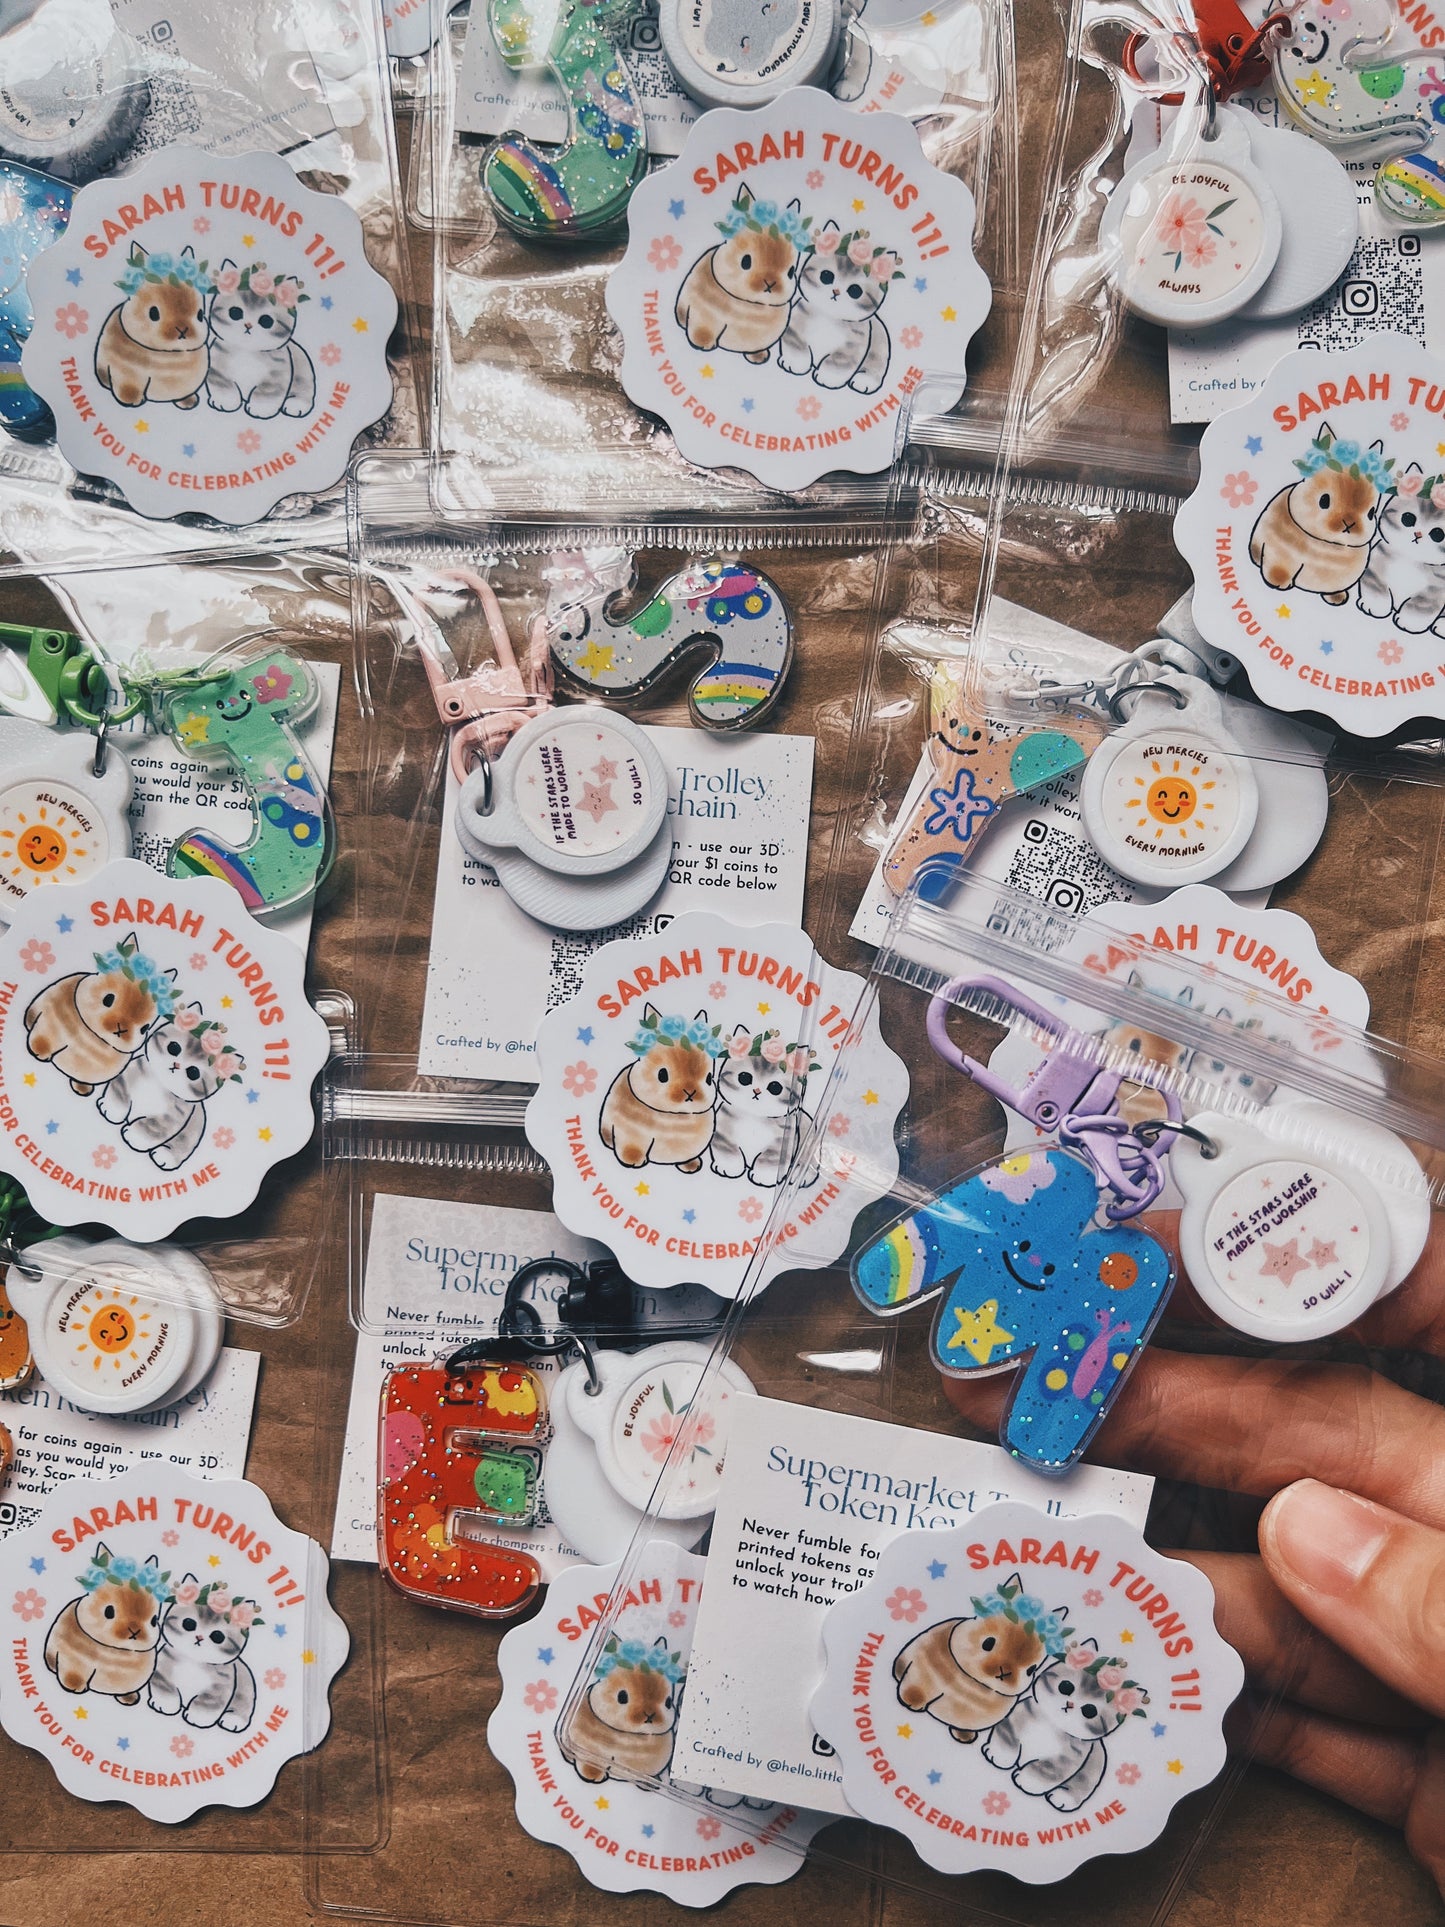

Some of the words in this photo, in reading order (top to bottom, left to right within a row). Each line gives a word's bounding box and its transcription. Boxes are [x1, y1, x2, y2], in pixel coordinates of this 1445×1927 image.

[757, 26, 805, 78] WONDERFULLY
[801, 1, 812, 27] MADE
[879, 71, 906, 100] ME
[692, 130, 805, 195] SARAH
[821, 132, 919, 211] TURNS
[911, 211, 950, 261] 11!
[1190, 174, 1230, 193] JOYFUL
[83, 184, 186, 259] SARAH
[199, 181, 303, 237] TURNS
[304, 233, 345, 280] 11!
[1158, 279, 1201, 294] ALWAYS
[643, 289, 665, 355] THANK
[658, 360, 686, 397] YOU
[683, 396, 717, 427] FOR
[719, 422, 852, 452] CELEBRATING
[854, 393, 900, 432] WITH
[1188, 377, 1237, 392] Crafted
[1241, 377, 1256, 392] by
[1272, 372, 1391, 433] SARAH
[61, 357, 96, 422] THANK
[93, 422, 125, 457] YOU
[127, 453, 162, 480] FOR
[167, 452, 296, 491] CELEBRATING
[295, 412, 335, 453] WITH
[329, 382, 350, 409] ME
[1215, 526, 1239, 594] THANK
[1231, 597, 1262, 636] YOU
[1258, 635, 1295, 670] FOR
[1297, 664, 1436, 697] CELEBRATING
[130, 757, 165, 770] coins
[170, 760, 209, 774] again
[539, 745, 553, 774] WERE
[552, 746, 569, 793] WORSHIP
[1142, 746, 1163, 760] NEW
[1166, 745, 1209, 765] MERCIES
[152, 775, 192, 789] would
[196, 781, 226, 794] your
[230, 779, 244, 793] $1
[544, 777, 559, 808] STARS
[628, 765, 643, 790] WILL
[676, 767, 774, 801] Trolley
[36, 793, 58, 805] NEW
[58, 800, 93, 833] MERCIES
[132, 787, 163, 803] Scan
[169, 792, 190, 806] the
[195, 793, 219, 808] QR
[560, 796, 571, 810] TO
[632, 791, 643, 806] SO
[1039, 795, 1051, 808] it
[550, 812, 562, 832] THE
[562, 812, 578, 840] MADE
[555, 836, 565, 844] IF
[699, 842, 723, 853] use
[729, 844, 753, 855] our
[759, 843, 780, 857] 3D
[1125, 834, 1157, 854] EVERY
[1158, 842, 1205, 857] MORNING
[461, 874, 477, 887] to
[669, 857, 700, 871] your
[704, 856, 719, 871] $1
[724, 860, 759, 873] coins
[764, 862, 779, 875] to
[669, 870, 693, 885] QR
[698, 873, 731, 888] code
[736, 874, 778, 891] below
[1216, 928, 1312, 1003] TURNS
[89, 896, 206, 940] SARAH
[211, 927, 285, 1027] TURNS
[261, 1038, 292, 1081] 11!
[596, 948, 703, 1019] SARAH
[717, 947, 822, 1008] TURNS
[436, 1033, 483, 1049] Crafted
[487, 1037, 502, 1053] by
[14, 1133, 132, 1203] CELEBRATING
[138, 1179, 188, 1203] WITH
[191, 1162, 221, 1187] ME
[565, 1115, 597, 1182] THANK
[591, 1182, 625, 1219] YOU
[623, 1215, 660, 1247] FOR
[798, 1182, 840, 1226] WITH
[1213, 1237, 1226, 1252] IF
[1226, 1220, 1249, 1242] THE
[1248, 1195, 1283, 1226] STARS
[1281, 1172, 1314, 1200] WERE
[1226, 1233, 1256, 1262] MADE
[1254, 1222, 1272, 1238] TO
[1271, 1185, 1319, 1227] WORSHIP
[1302, 1296, 1318, 1311] SO
[1319, 1277, 1346, 1301] WILL
[58, 1311, 70, 1333] NEW
[386, 1305, 431, 1324] Never
[122, 1362, 148, 1388] EVERY
[146, 1321, 170, 1366] MORNING
[382, 1341, 428, 1359] unlock
[623, 1422, 634, 1437] BE
[629, 1383, 655, 1420] JOYFUL
[16, 1448, 32, 1459] as
[36, 1450, 60, 1464] you
[65, 1454, 105, 1470] would
[18, 1425, 39, 1442] for
[43, 1433, 78, 1449] coins
[83, 1438, 123, 1455] again
[169, 1452, 192, 1466] our
[198, 1454, 218, 1470] 3D
[767, 1445, 977, 1513] Supermarket
[801, 1480, 898, 1527] Token
[51, 1496, 159, 1553] SARAH
[173, 1497, 273, 1564] TURNS
[266, 1565, 306, 1609] 11!
[742, 1517, 790, 1541] Never
[797, 1529, 852, 1555] fumble
[735, 1557, 785, 1578] unlock
[791, 1570, 826, 1587] your
[738, 1540, 796, 1562] printed
[801, 1551, 852, 1574] tokens
[857, 1566, 876, 1580] as
[732, 1574, 748, 1588] to
[753, 1581, 799, 1600] watch
[804, 1587, 836, 1607] how
[965, 1536, 1101, 1576] SARAH
[1108, 1560, 1195, 1659] TURNS
[1169, 1668, 1203, 1713] 11!
[852, 1632, 885, 1697] THANK
[12, 1638, 40, 1699] THANK
[33, 1701, 63, 1737] YOU
[61, 1734, 95, 1765] FOR
[98, 1759, 225, 1788] CELEBRATING
[226, 1731, 269, 1769] WITH
[264, 1705, 289, 1732] ME
[853, 1703, 877, 1744] YOU
[693, 1740, 743, 1763] Crafted
[747, 1752, 763, 1769] by
[866, 1746, 897, 1786] FOR
[527, 1731, 558, 1794] THANK
[553, 1795, 585, 1830] YOU
[584, 1826, 620, 1857] FOR
[624, 1841, 756, 1873] CELEBRATING
[894, 1785, 1030, 1848] CELEBRATING
[1094, 1800, 1127, 1826] ME
[1036, 1818, 1092, 1846] WITH
